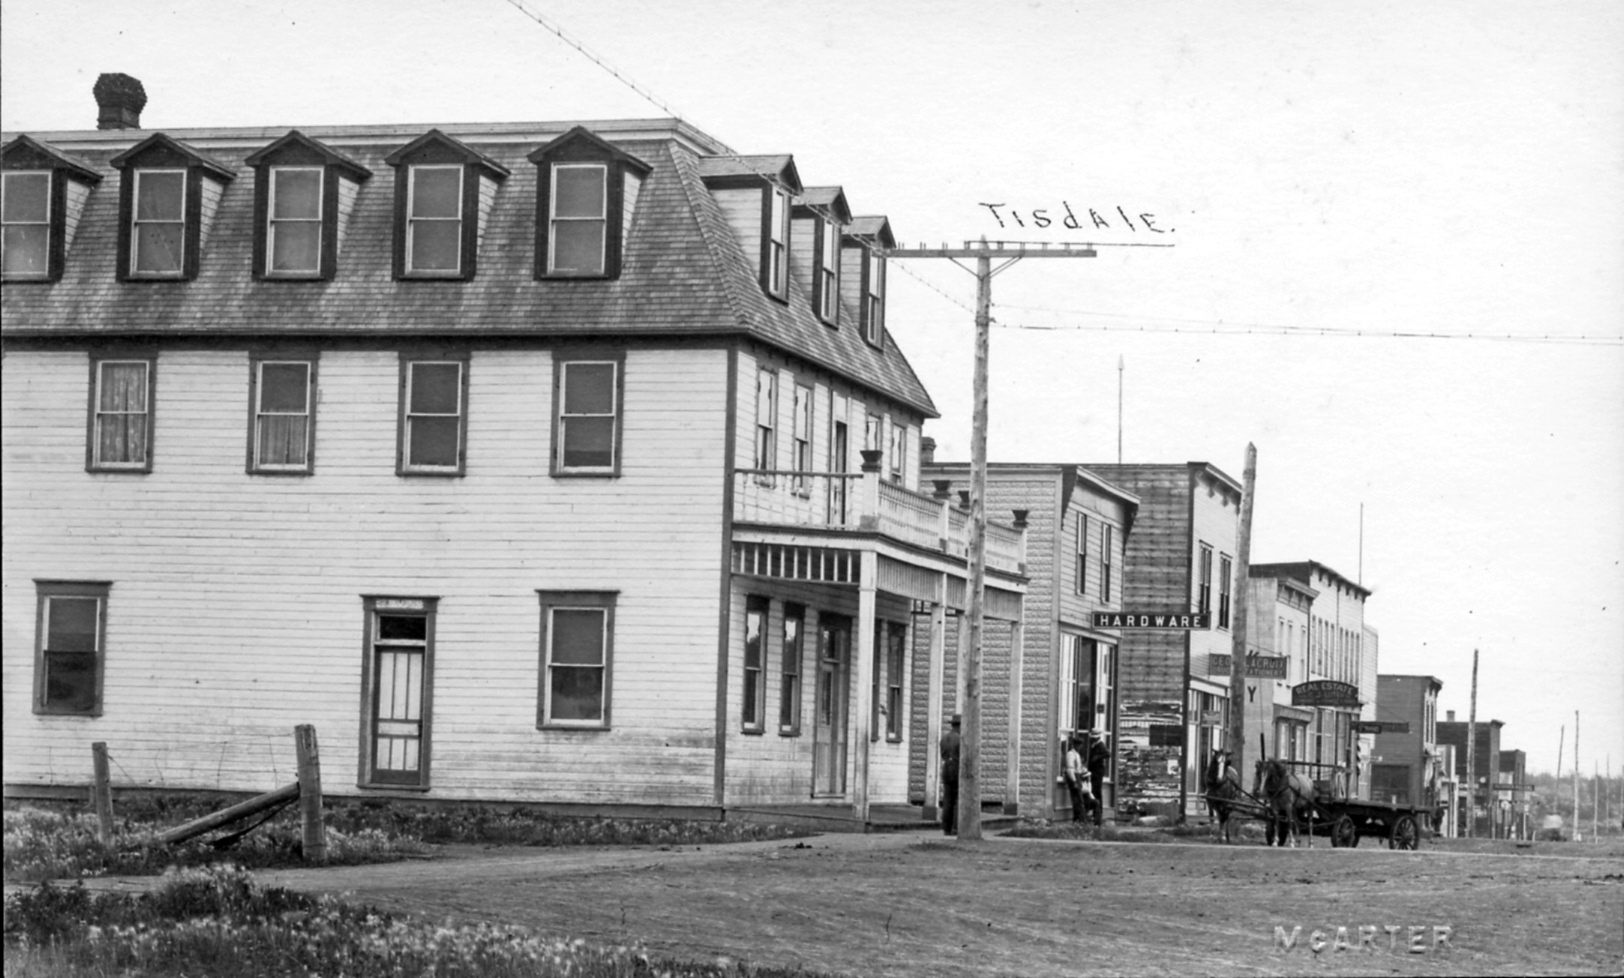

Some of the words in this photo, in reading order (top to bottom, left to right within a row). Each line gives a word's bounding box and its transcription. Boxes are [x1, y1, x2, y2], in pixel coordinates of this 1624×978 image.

[1100, 615, 1201, 627] HARDWARE
[1296, 683, 1319, 695] REAL
[1321, 681, 1354, 695] ESTATE
